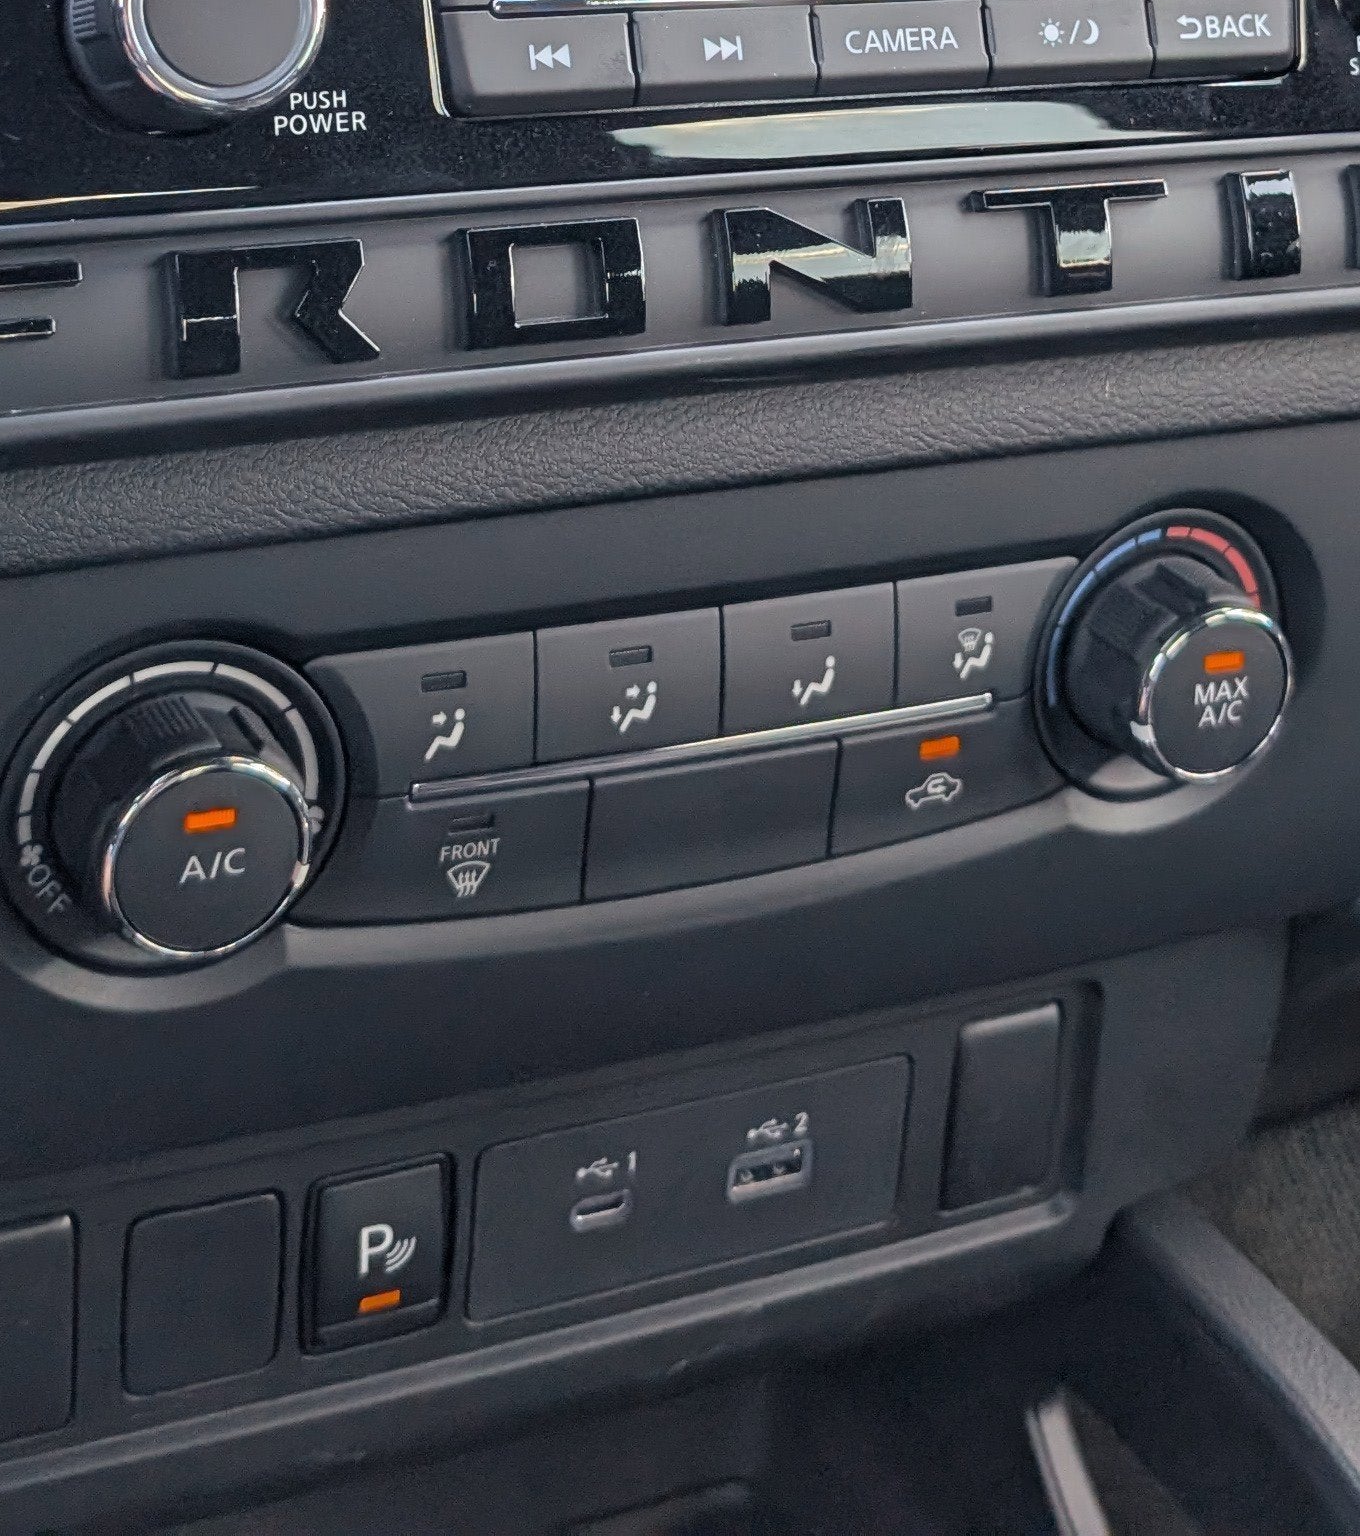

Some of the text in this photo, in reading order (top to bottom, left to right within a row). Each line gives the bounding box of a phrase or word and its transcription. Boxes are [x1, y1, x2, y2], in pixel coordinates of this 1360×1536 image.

[844, 25, 959, 54] CAMERA
[1205, 13, 1272, 40] BACK
[289, 89, 347, 112] PUSH
[273, 110, 367, 136] POWER
[1193, 675, 1249, 706] MAX
[1197, 701, 1243, 729] A/C
[440, 837, 501, 863] FRONT
[179, 848, 247, 886] A/C
[25, 865, 73, 917] OFF
[793, 1110, 810, 1138] 2
[626, 1149, 638, 1173] 1
